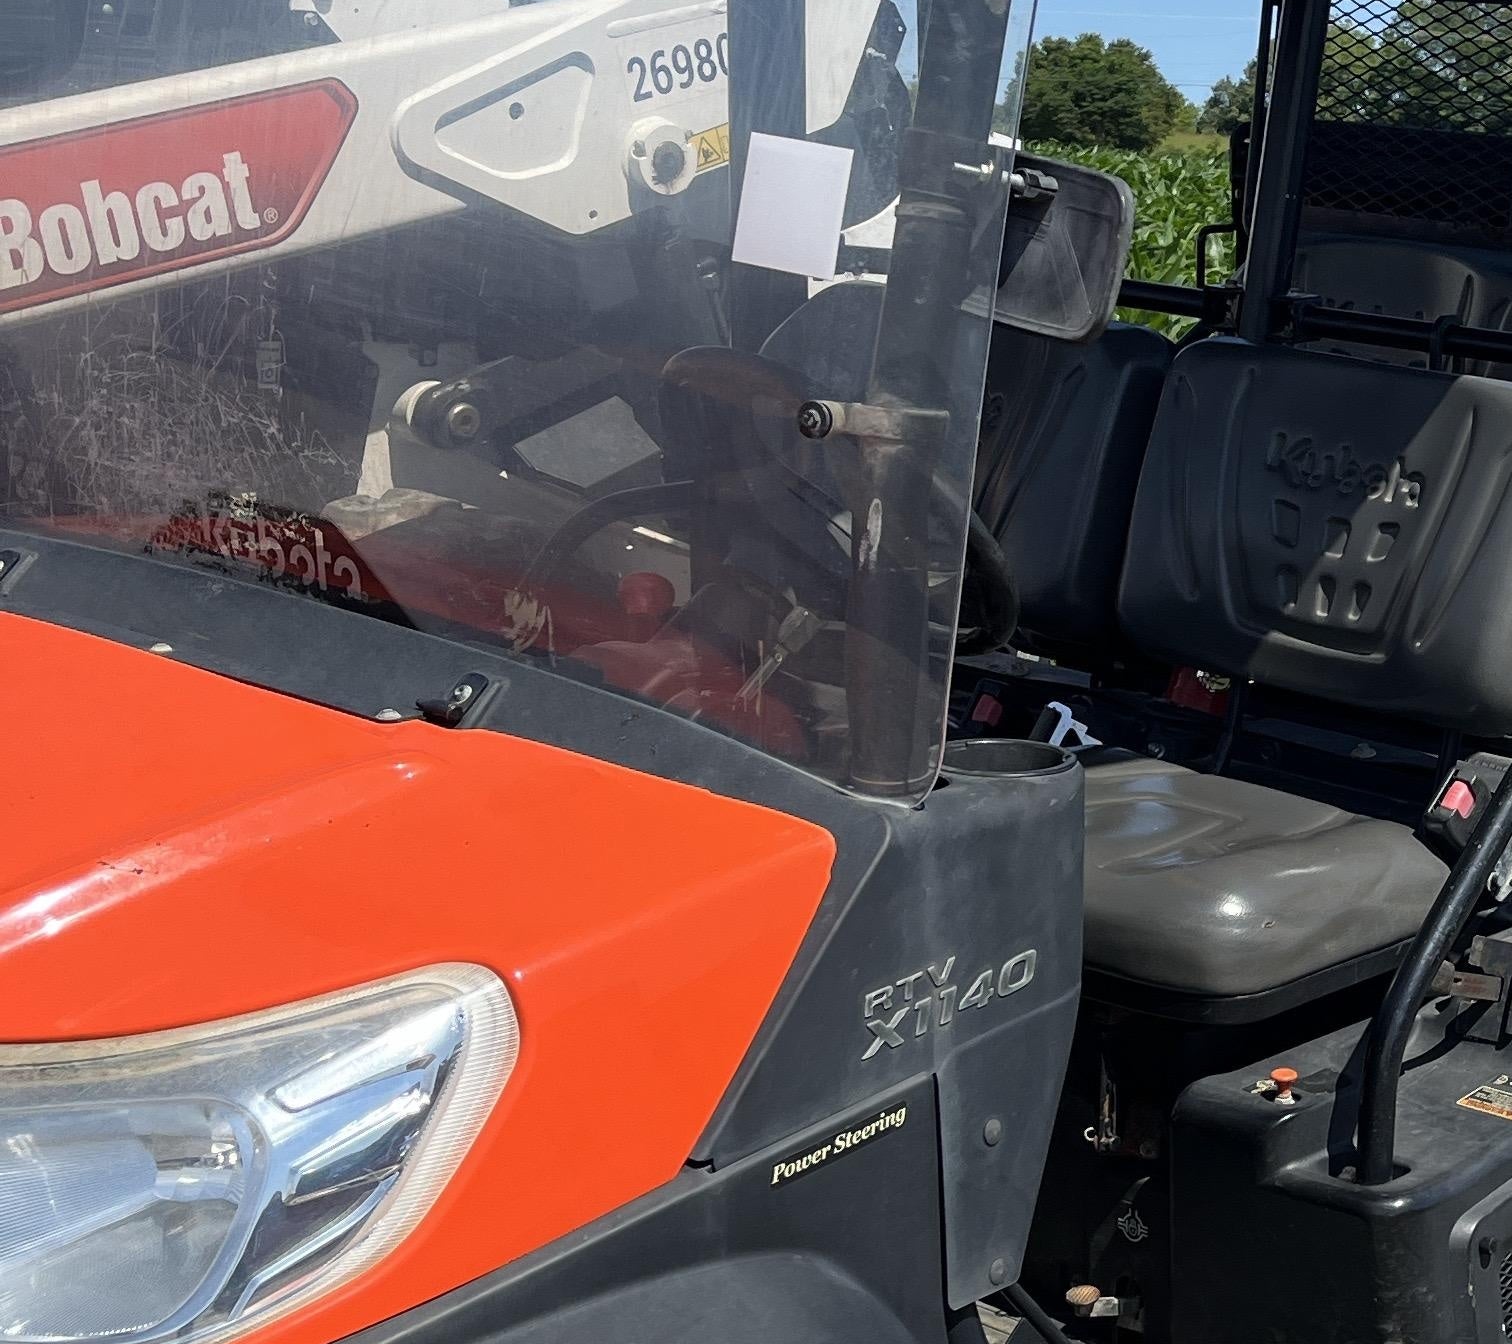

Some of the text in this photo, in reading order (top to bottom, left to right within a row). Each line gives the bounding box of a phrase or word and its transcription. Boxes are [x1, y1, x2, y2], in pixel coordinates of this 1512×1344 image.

[0, 150, 262, 290] Bobcat
[1264, 430, 1425, 509] Kubota
[860, 949, 1038, 1062] X1140
[864, 955, 957, 1019] RTV
[770, 1106, 907, 1186] Power Steering
